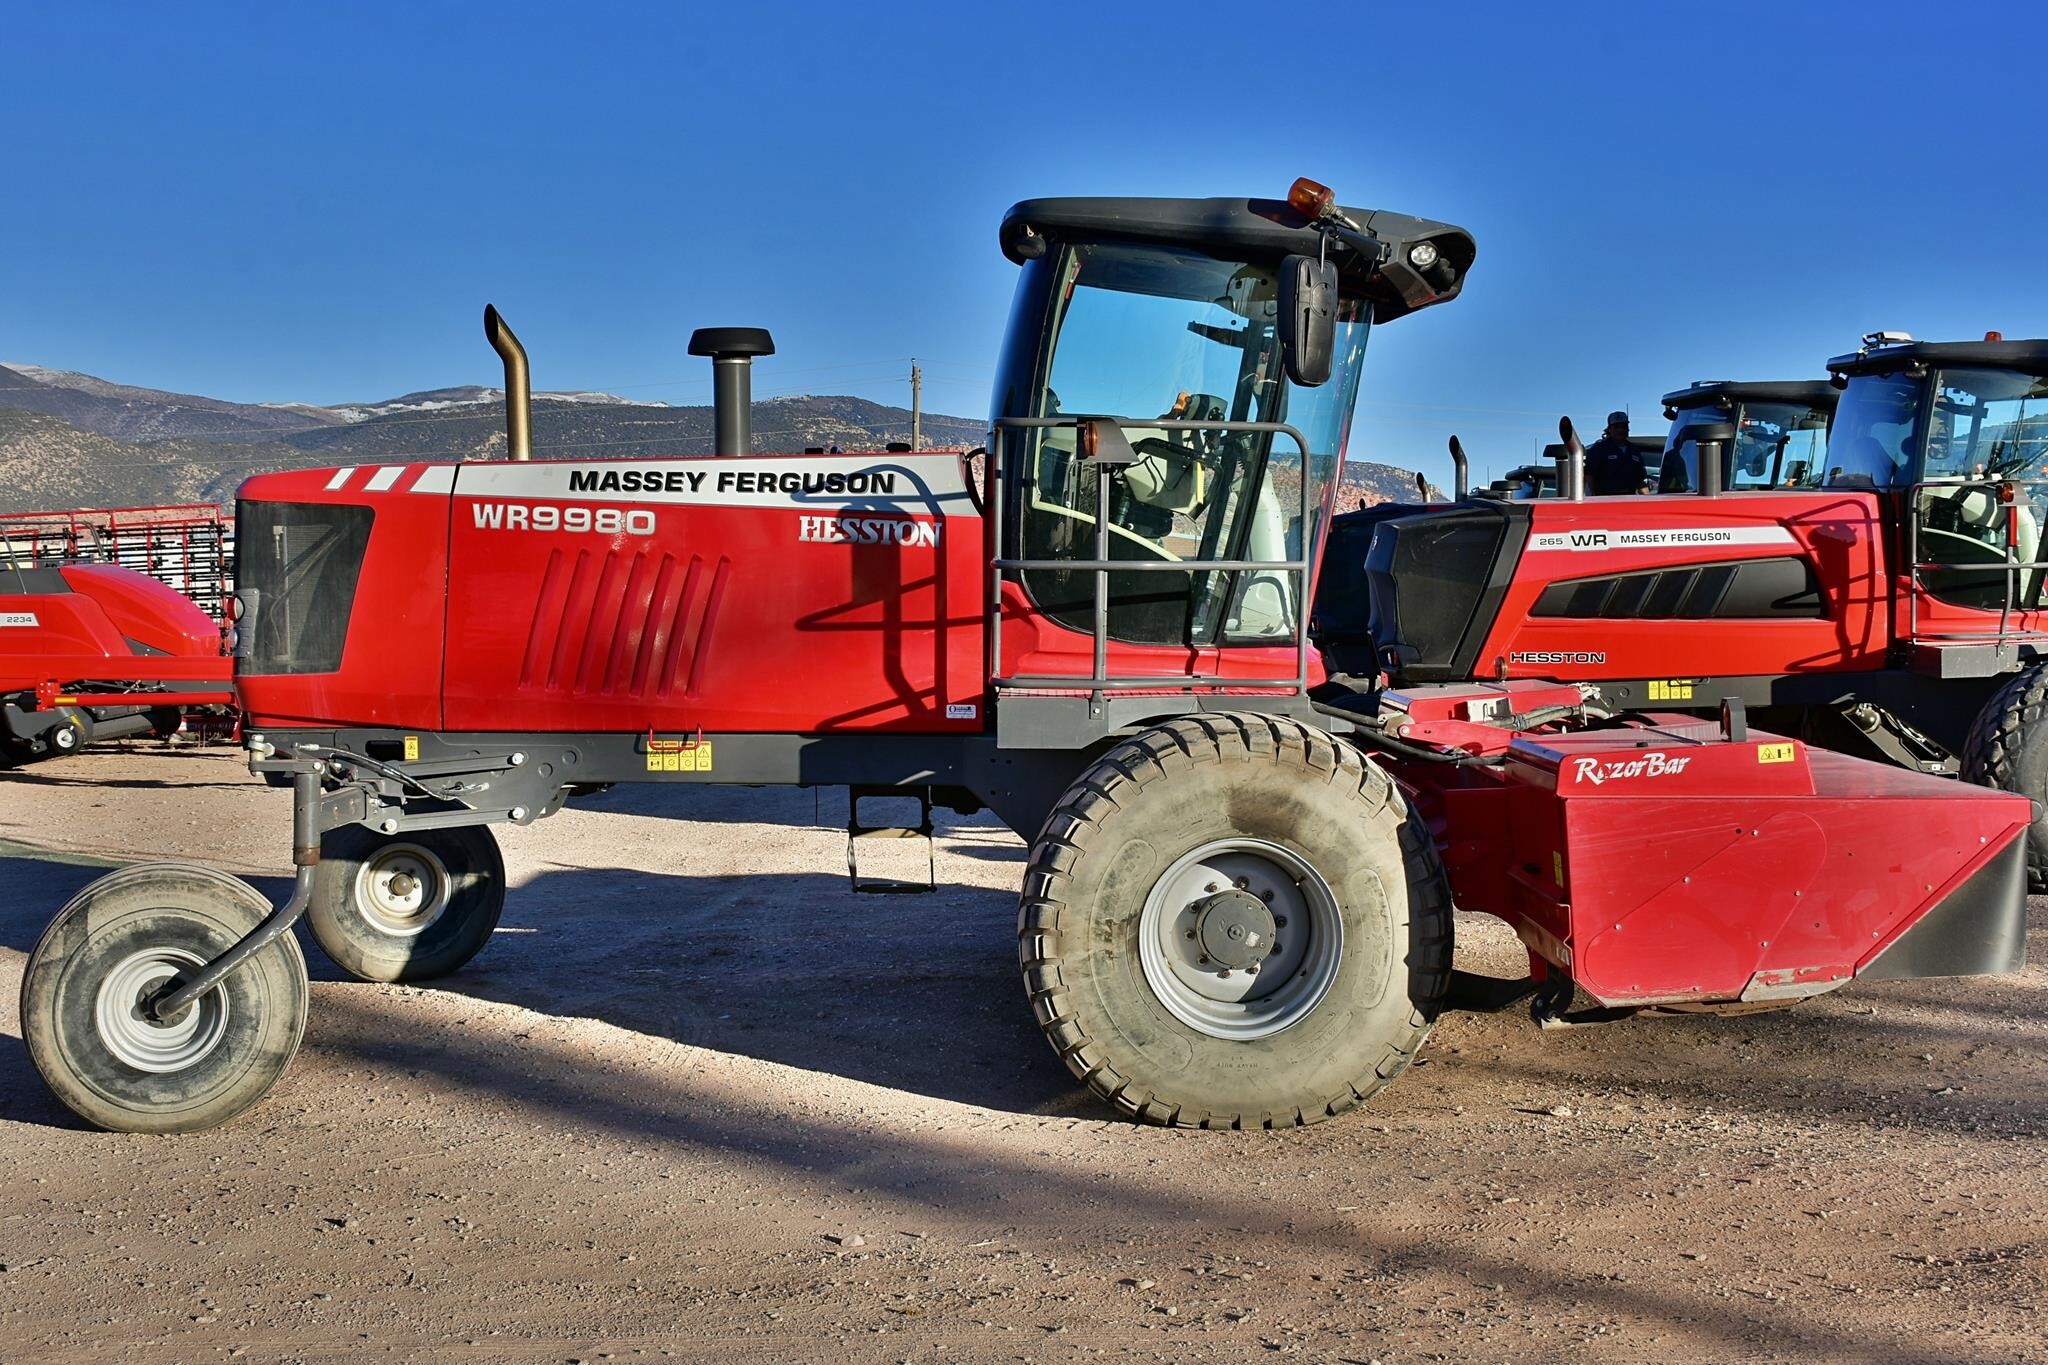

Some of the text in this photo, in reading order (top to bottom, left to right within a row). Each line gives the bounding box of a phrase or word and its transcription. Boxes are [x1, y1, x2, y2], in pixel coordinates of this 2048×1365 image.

[569, 470, 895, 494] MASSEY FERGUSON
[472, 503, 656, 535] WR9980
[798, 515, 942, 548] HESSTON
[1539, 532, 1731, 547] 265 WR MASSEY FERGUSON
[1510, 652, 1606, 664] HESSTON
